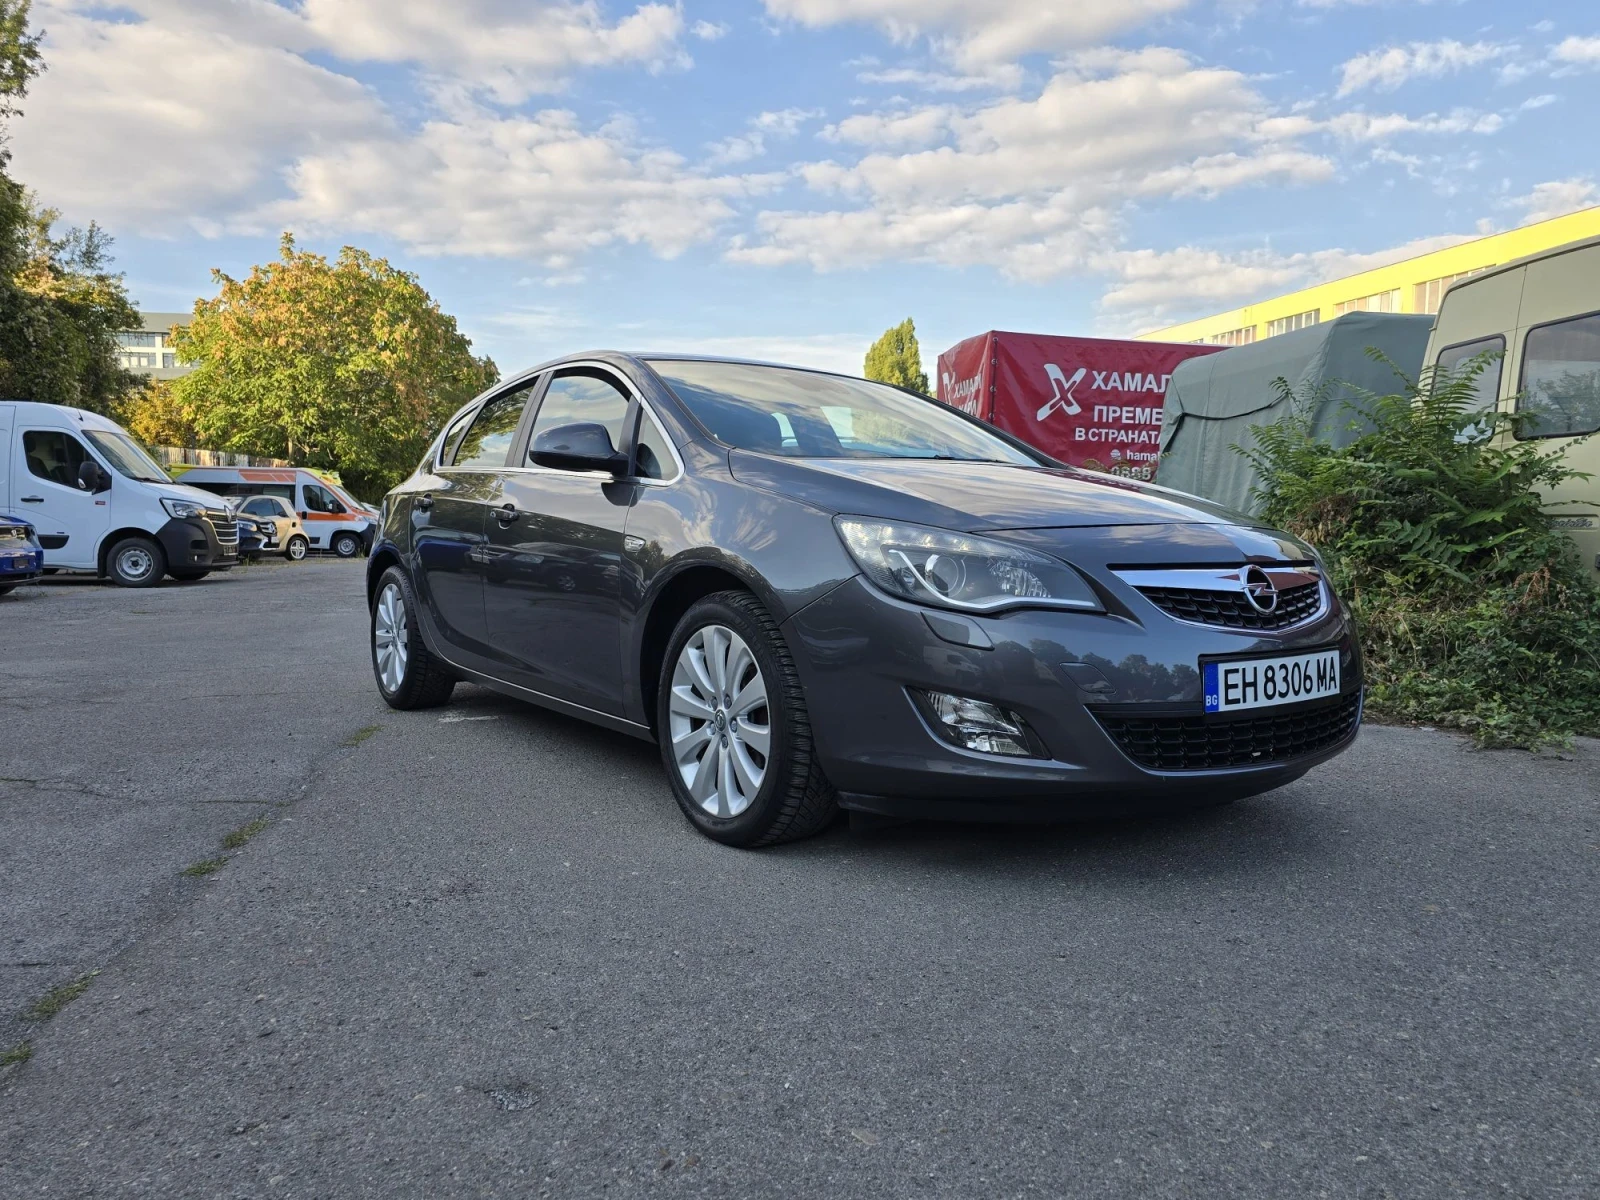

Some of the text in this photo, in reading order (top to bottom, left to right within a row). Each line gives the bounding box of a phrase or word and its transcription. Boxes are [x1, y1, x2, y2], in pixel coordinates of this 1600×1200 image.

[1093, 405, 1163, 425] ПРЕМЕ
[1075, 427, 1086, 441] В
[1224, 656, 1337, 706] EH 8306 MA
[1205, 695, 1218, 706] BG
